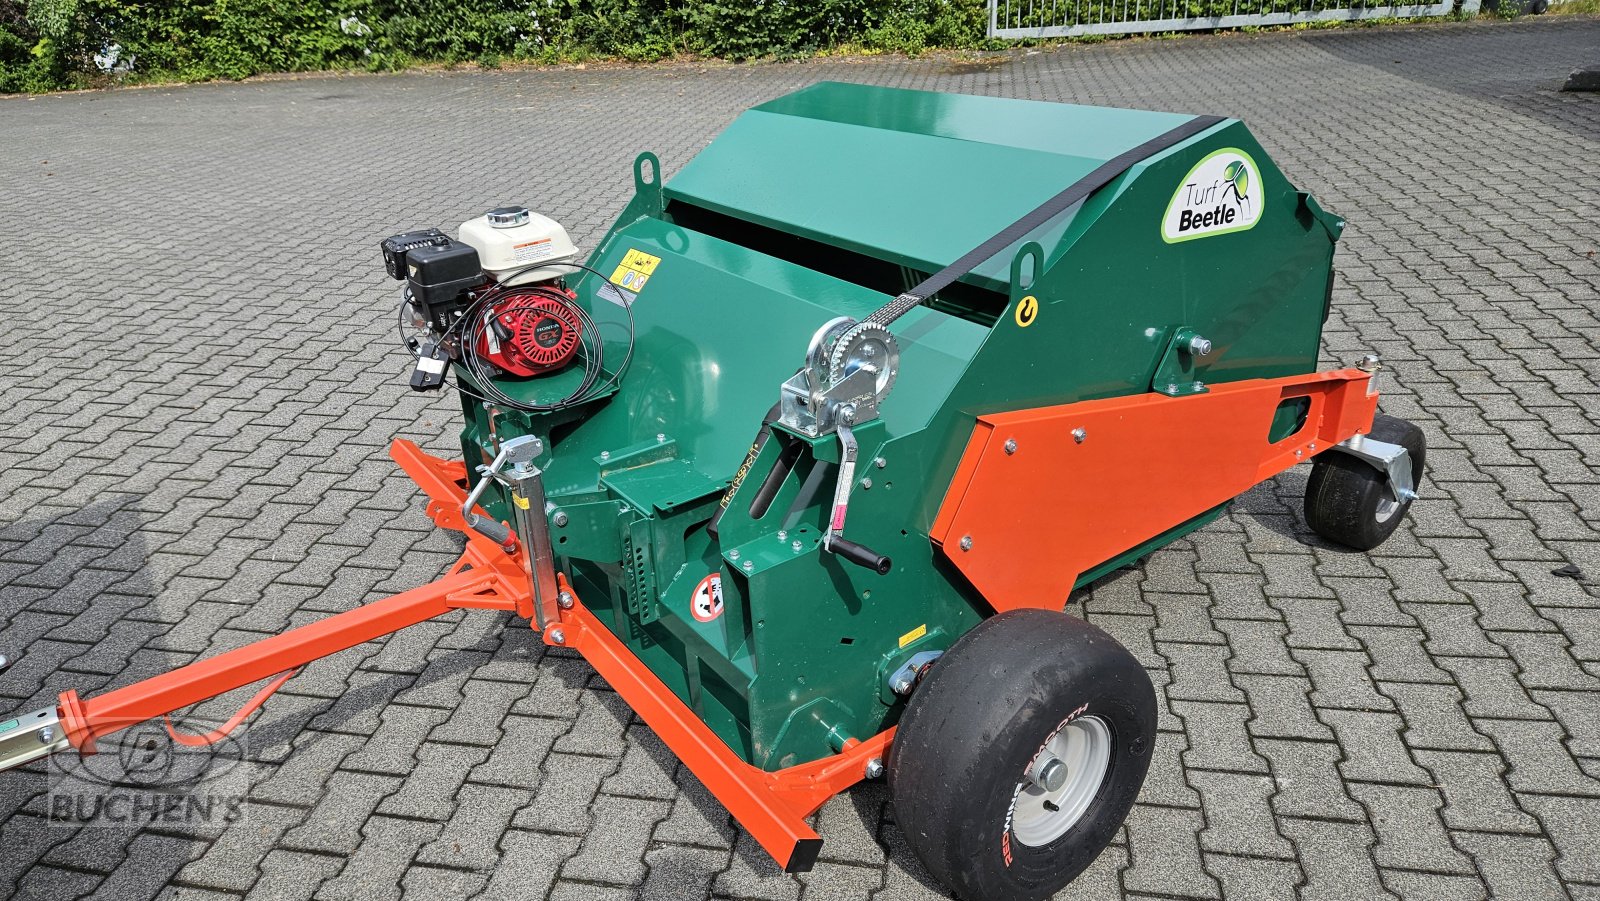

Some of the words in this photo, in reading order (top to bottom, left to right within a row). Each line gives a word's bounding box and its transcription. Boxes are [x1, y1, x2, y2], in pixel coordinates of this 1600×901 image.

[1186, 179, 1219, 207] Turf
[1179, 203, 1236, 232] Beetle
[536, 323, 560, 333] HONDA
[538, 329, 560, 341] GX
[1002, 782, 1023, 868] REDWING
